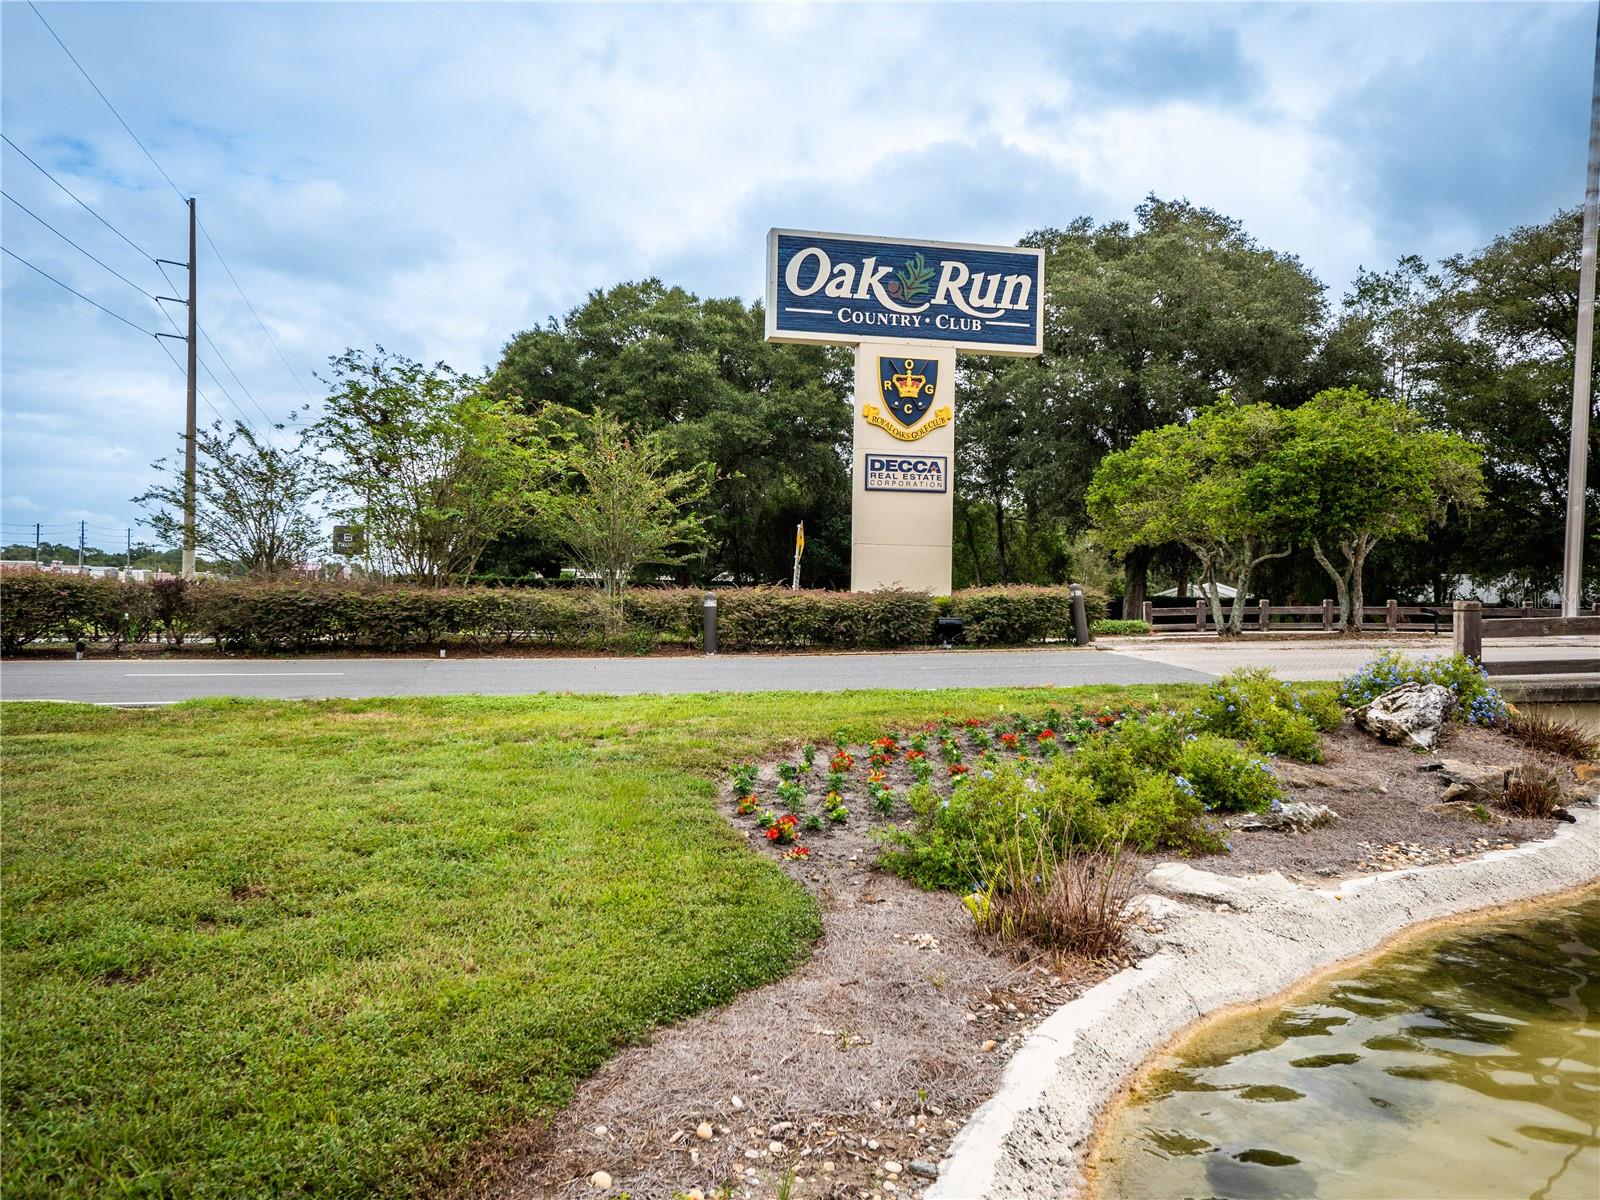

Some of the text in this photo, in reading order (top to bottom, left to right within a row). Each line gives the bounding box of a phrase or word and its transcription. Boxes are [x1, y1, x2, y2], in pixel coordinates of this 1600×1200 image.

[785, 247, 1032, 318] Oak Run
[837, 307, 982, 331] COUNTRY CLUB
[904, 360, 914, 369] O
[884, 380, 934, 394] R G
[904, 404, 912, 414] C
[872, 415, 947, 439] ROYAL OAKS GOLF CLUB
[870, 458, 942, 473] DECCA
[869, 479, 943, 488] CORPORATION
[870, 472, 942, 481] REAL ESTATE
